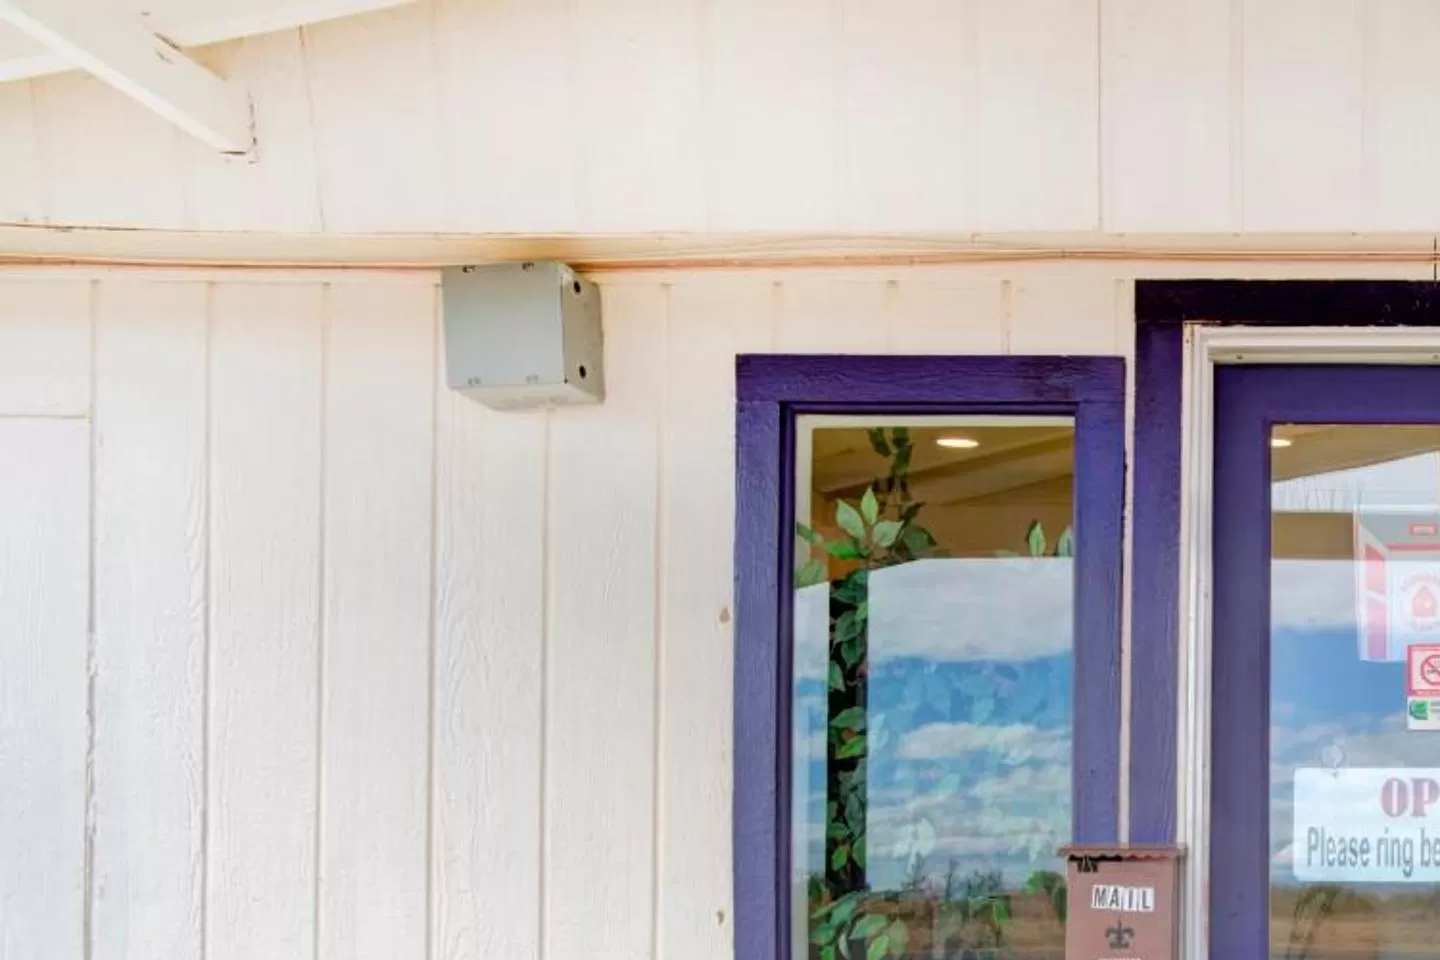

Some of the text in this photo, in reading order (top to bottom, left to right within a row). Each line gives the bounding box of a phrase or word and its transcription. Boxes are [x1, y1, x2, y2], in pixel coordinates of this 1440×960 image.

[1306, 826, 1370, 869] Please
[1376, 827, 1414, 878] ring
[1093, 886, 1151, 910] MAIL
